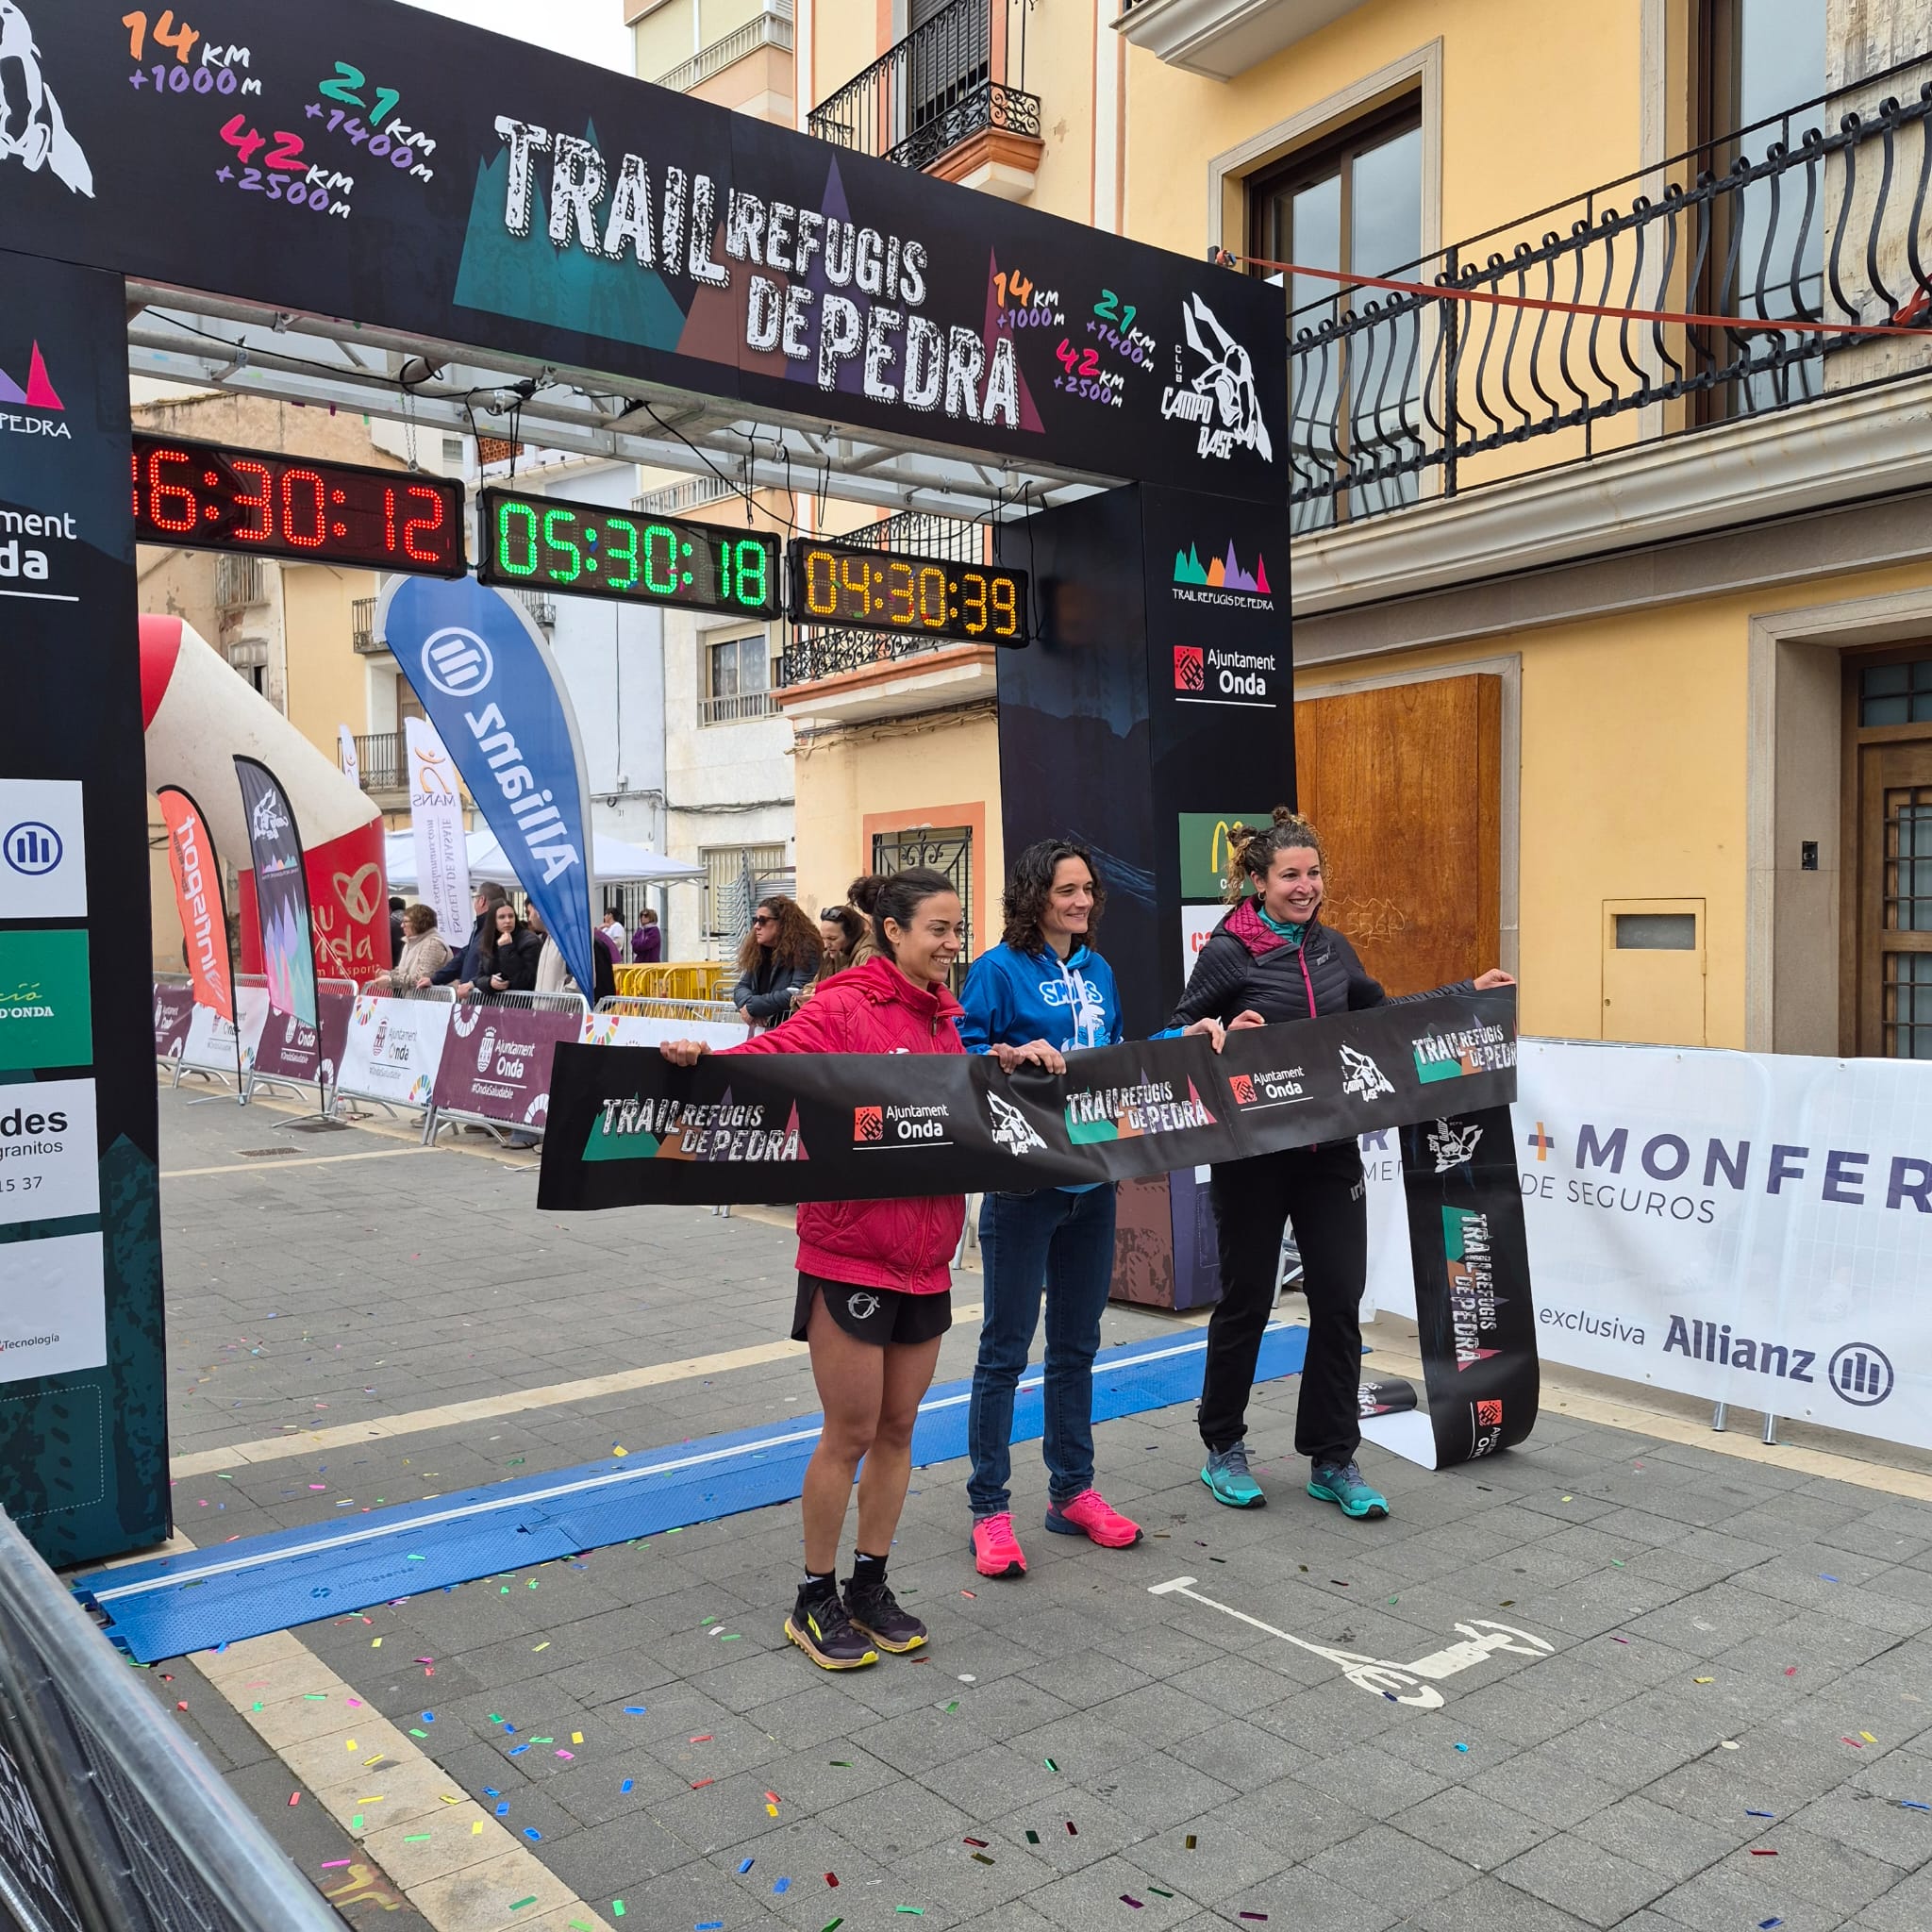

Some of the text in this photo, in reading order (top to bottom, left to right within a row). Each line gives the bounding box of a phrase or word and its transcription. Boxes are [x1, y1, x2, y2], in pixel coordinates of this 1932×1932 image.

[493, 114, 928, 307] TRAIL REFUGIS
[746, 274, 1020, 430] DE PEDRA
[1160, 387, 1214, 425] CAMPO
[1197, 426, 1236, 459] BASE
[131, 449, 443, 562] 6:30:12
[499, 502, 767, 606] 05:30:18
[807, 550, 1017, 636] 04:30:39
[1207, 648, 1276, 671] Ajuntament
[1219, 670, 1266, 696] Onda
[388, 1042, 409, 1061] Onda
[494, 1039, 536, 1058] Ajuntament
[1412, 1024, 1504, 1065] TRAIL REFUGIS
[1469, 1047, 1486, 1068] DE
[496, 1056, 525, 1079] Onda
[1253, 1065, 1306, 1085] Ajuntament
[471, 1082, 514, 1099] #OndaSaludable
[1066, 1081, 1173, 1125] TRAIL REFUGIS
[1264, 1080, 1304, 1100] Onda
[603, 1097, 766, 1138] TRAIL REFUGIS
[885, 1104, 950, 1120] Ajuntament
[897, 1118, 944, 1140] Onda
[1127, 1098, 1210, 1134] DE PEDRA
[680, 1128, 801, 1162] DE PEDRA
[23, 1175, 42, 1191] 37
[1520, 1173, 1556, 1199] DE
[1567, 1179, 1716, 1224] SEGUROS
[1460, 1213, 1497, 1332] TRAIL REFUGIS
[4, 1332, 60, 1350] Tecnología
[1450, 1295, 1483, 1363] PEDRA
[1540, 1307, 1817, 1384] exclusiva Allianz
